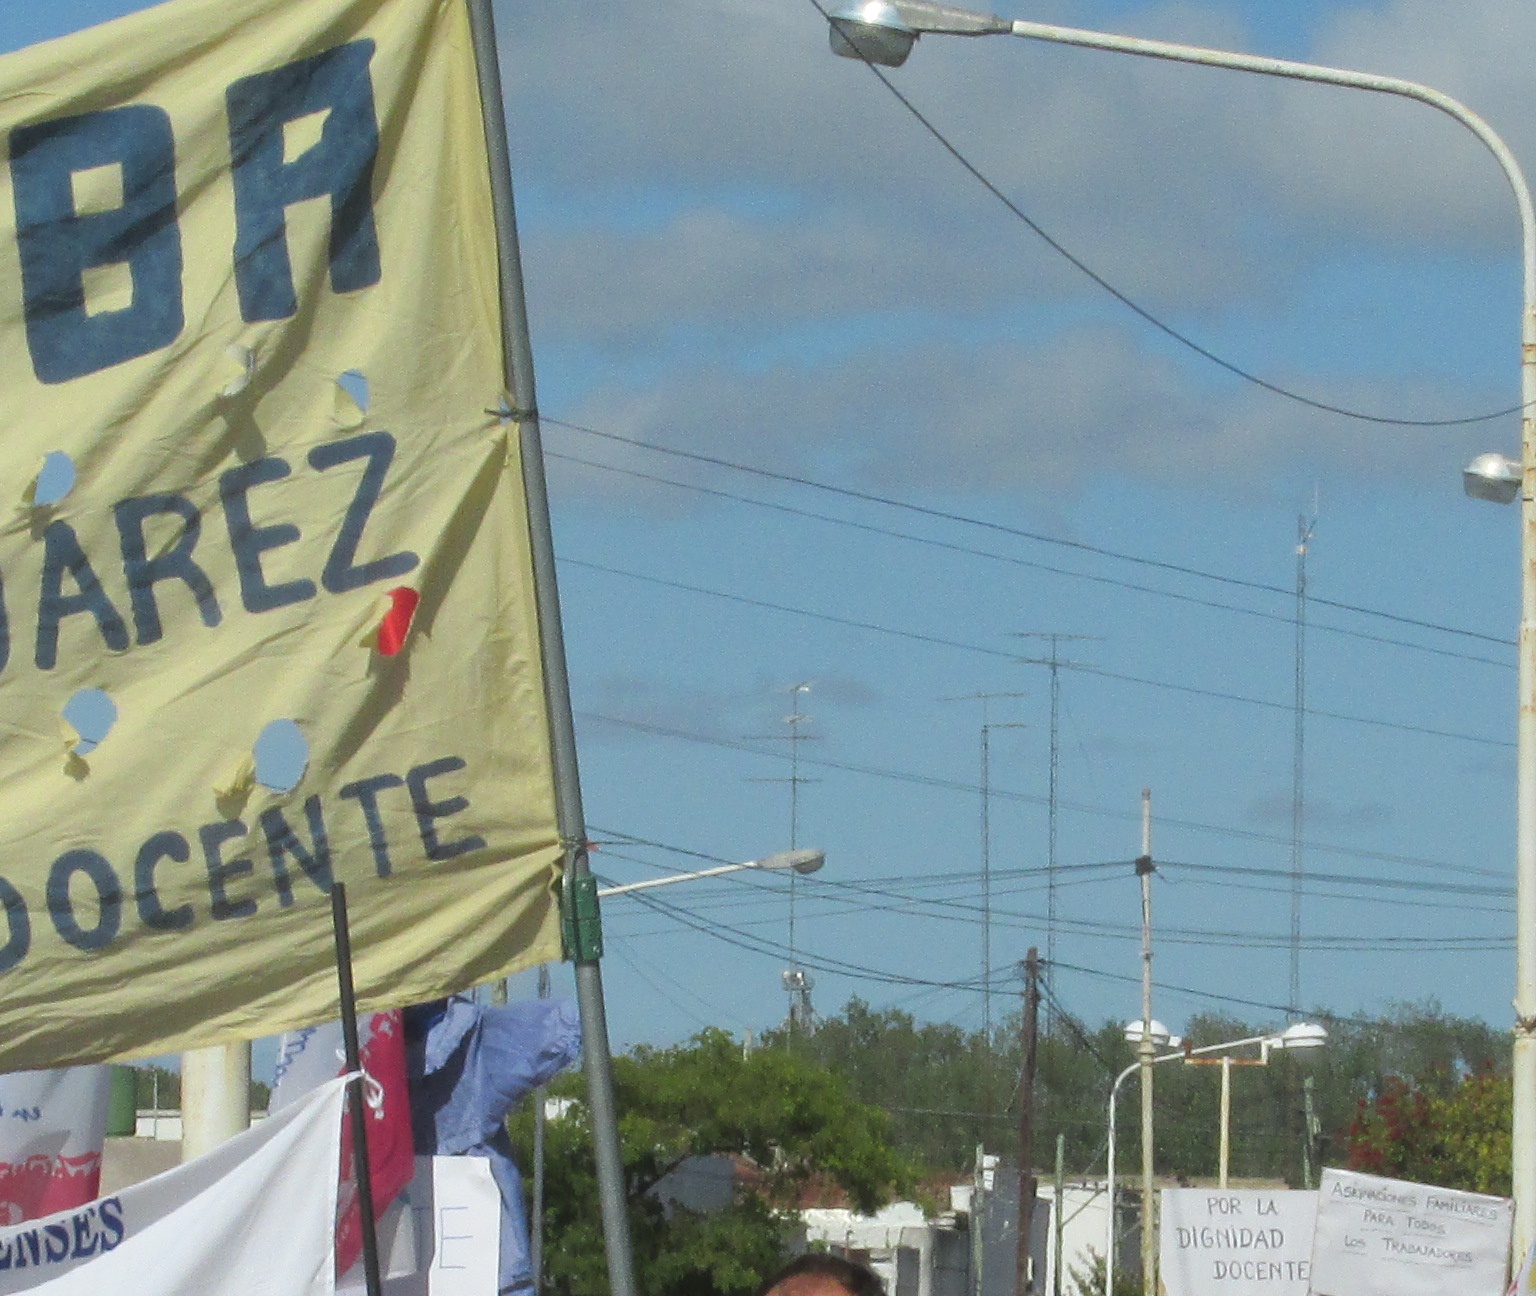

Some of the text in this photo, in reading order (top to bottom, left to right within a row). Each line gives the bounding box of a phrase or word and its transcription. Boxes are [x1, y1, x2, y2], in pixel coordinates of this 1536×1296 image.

[1206, 1197, 1279, 1217] POR LA
[1176, 1224, 1285, 1251] DIGNIDAD
[1212, 1260, 1310, 1282] DOCENTE
